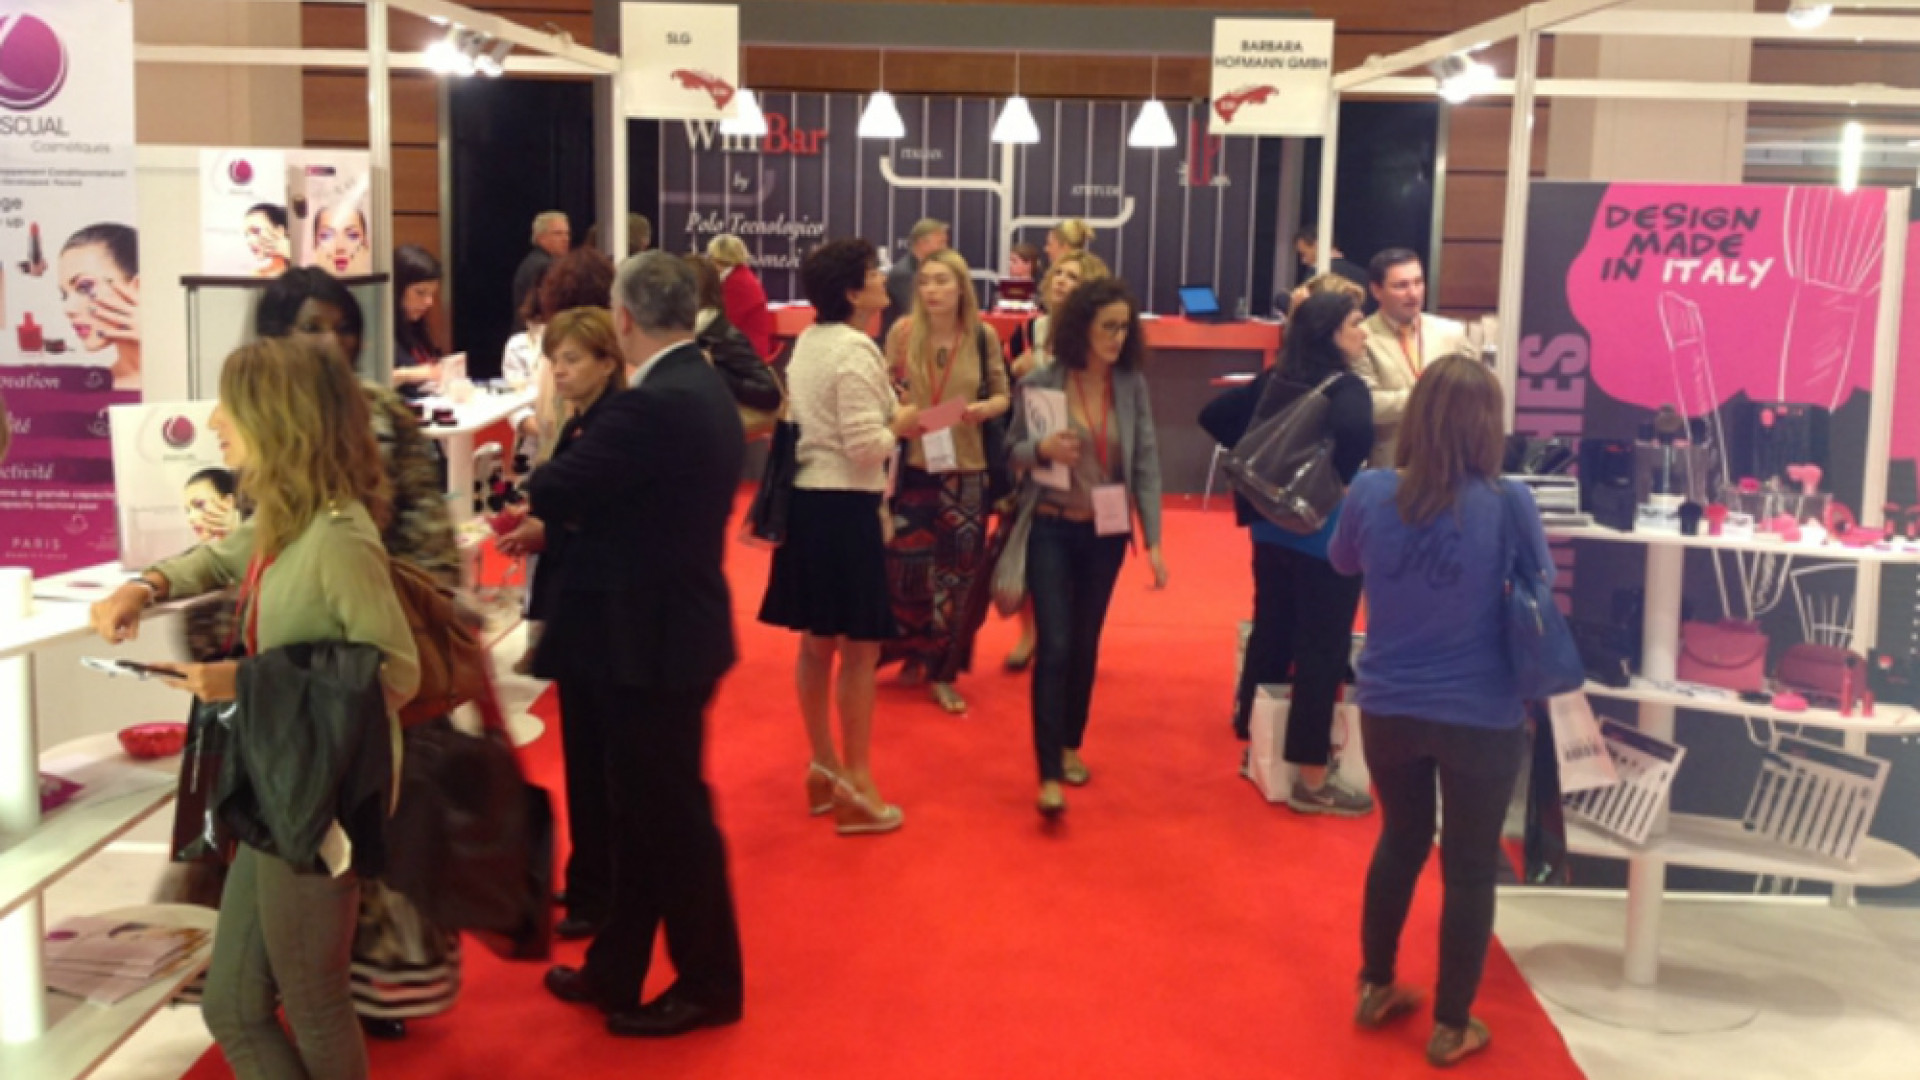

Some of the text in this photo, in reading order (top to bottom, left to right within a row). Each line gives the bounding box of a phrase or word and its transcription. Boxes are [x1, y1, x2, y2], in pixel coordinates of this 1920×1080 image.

[1241, 40, 1303, 52] BARBARA
[1214, 56, 1284, 69] HOFMANN
[685, 211, 725, 233] Polo
[1605, 203, 1761, 231] DESIGN
[1623, 232, 1744, 257] MADE
[1601, 257, 1774, 289] IN ITALY
